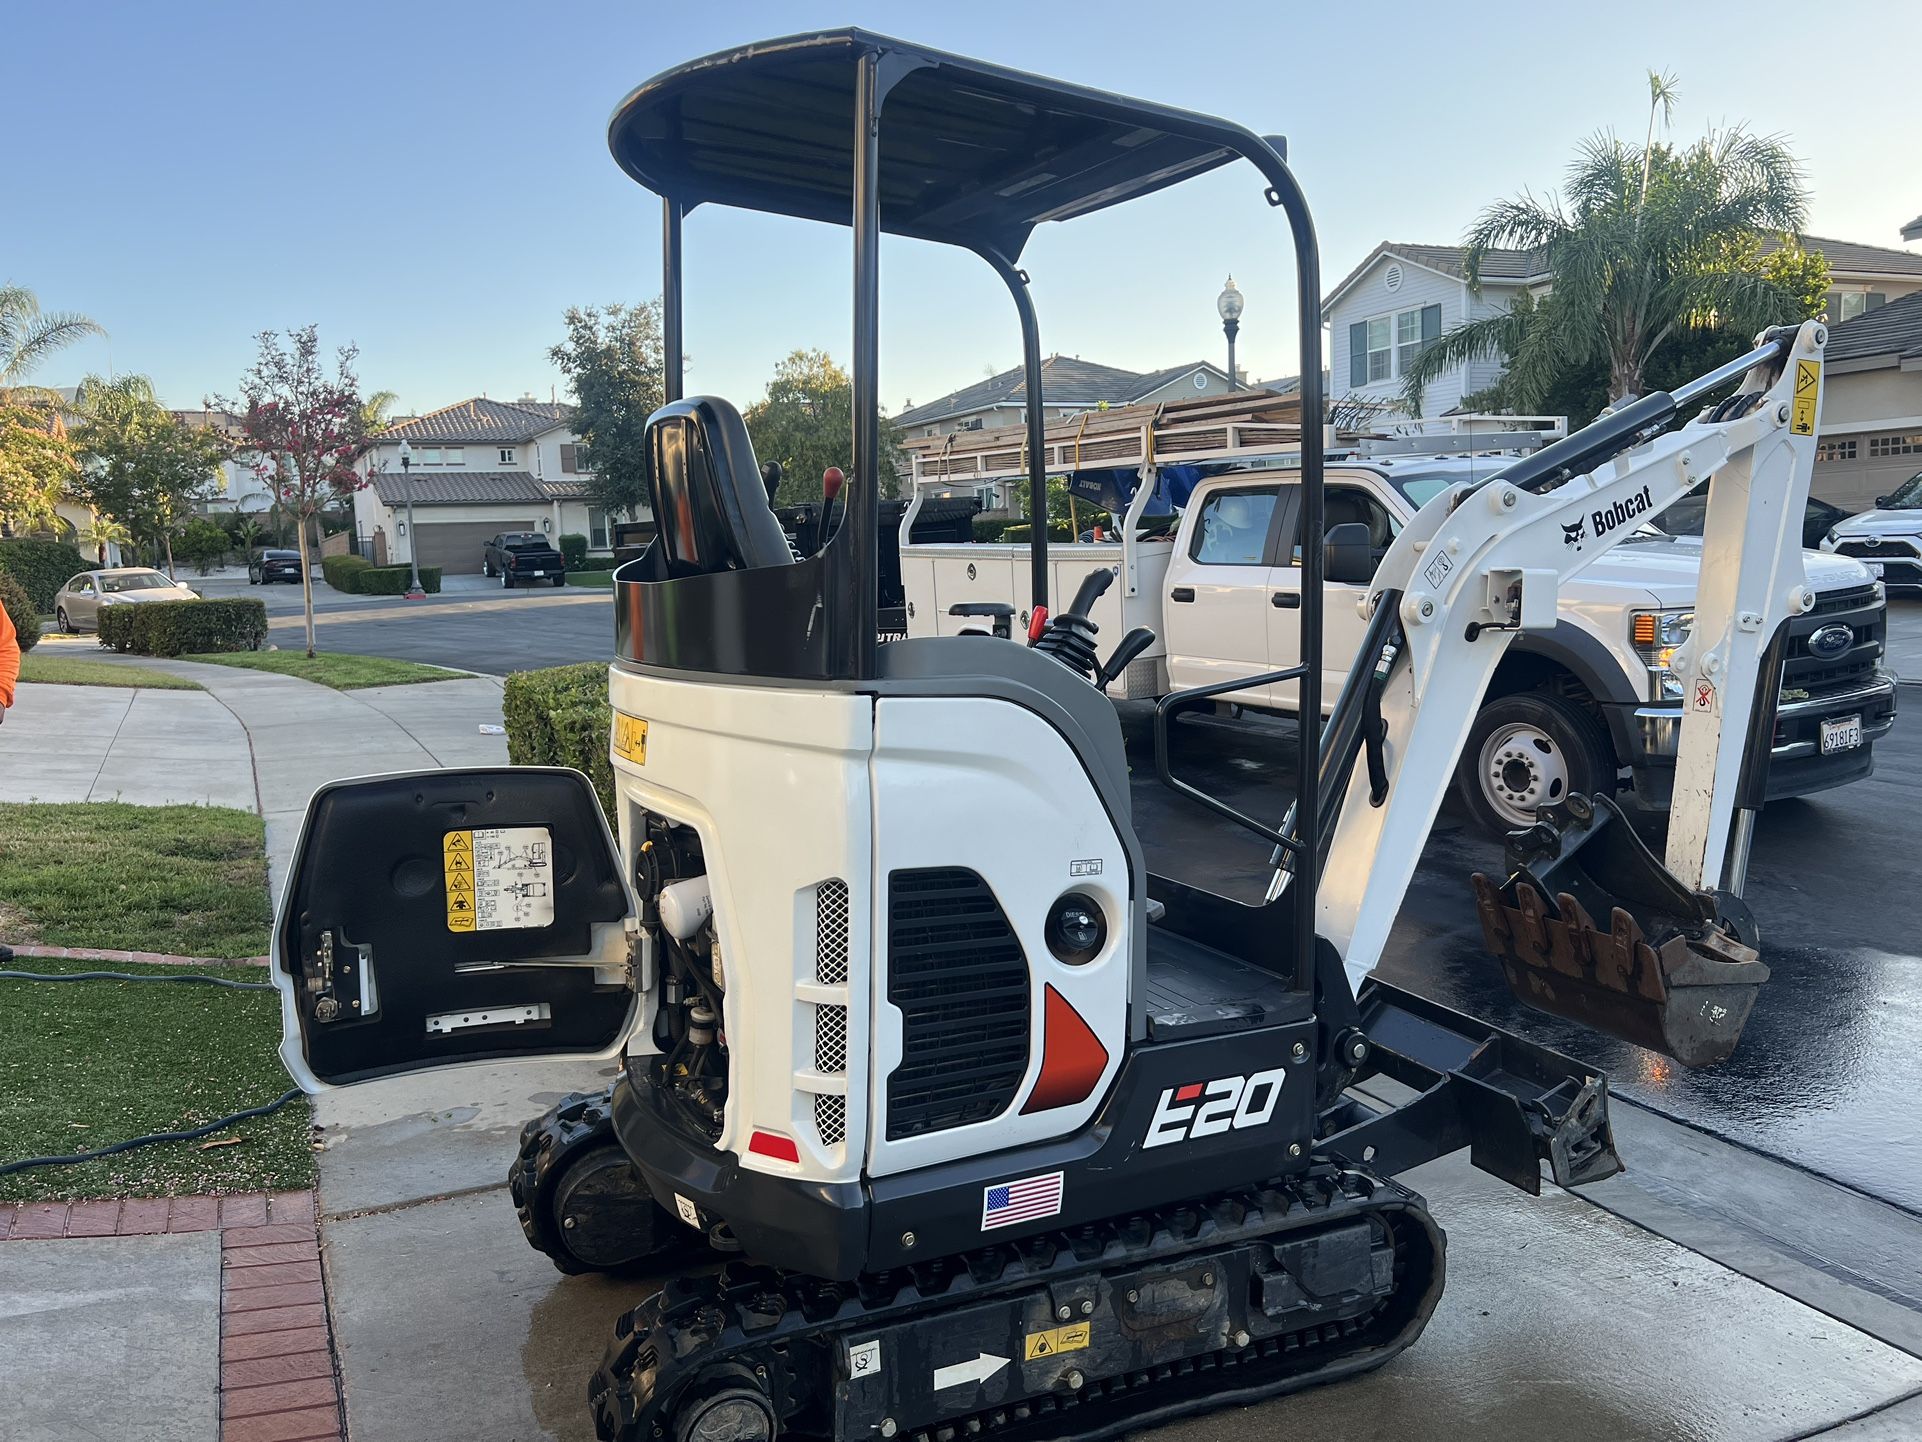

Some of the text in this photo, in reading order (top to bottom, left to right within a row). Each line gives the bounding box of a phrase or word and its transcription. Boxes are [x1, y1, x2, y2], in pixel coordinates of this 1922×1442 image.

[1591, 485, 1653, 538] Bobcat
[1824, 727, 1859, 748] 69181F3
[1142, 1067, 1286, 1149] E20
